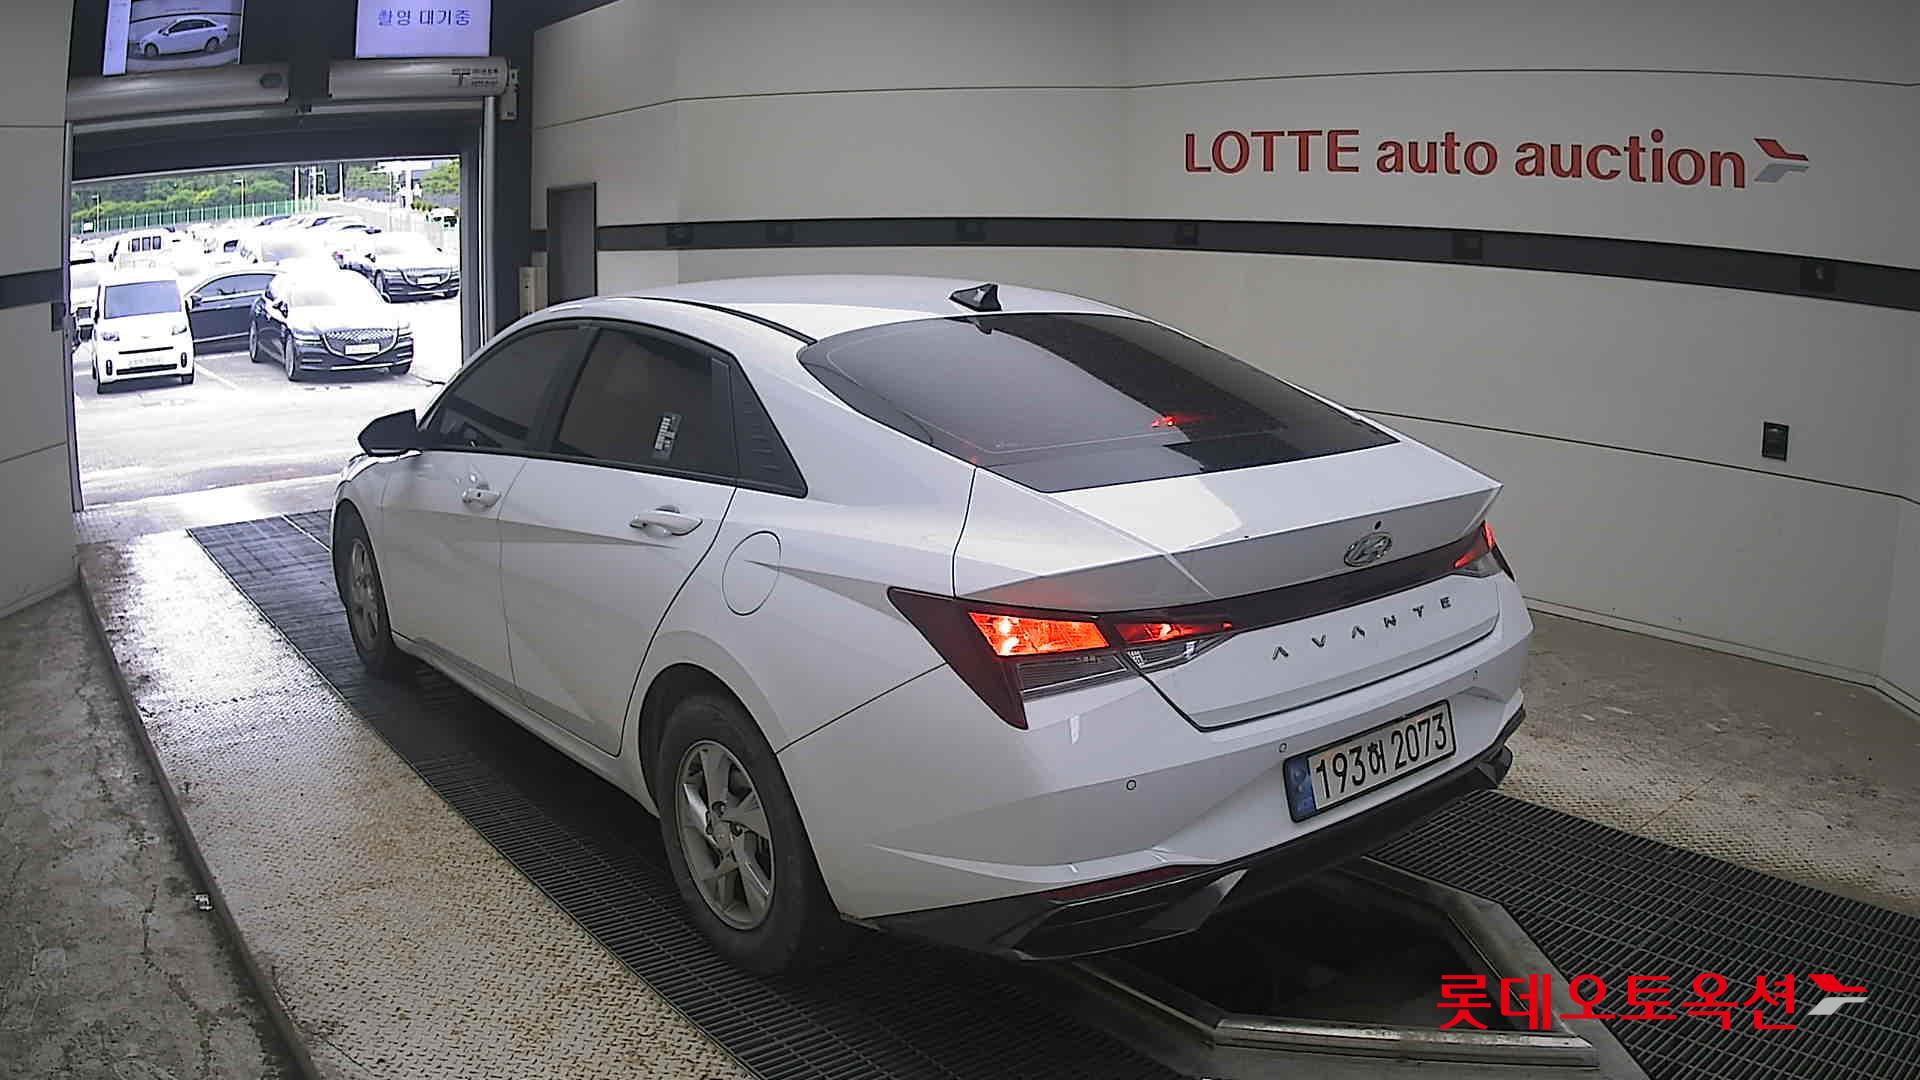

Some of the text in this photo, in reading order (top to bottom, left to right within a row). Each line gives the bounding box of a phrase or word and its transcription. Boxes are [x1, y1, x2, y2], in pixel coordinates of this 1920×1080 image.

[419, 9, 472, 26] 대기중
[1185, 128, 1746, 188] LOTTE auto auction
[1273, 596, 1452, 661] AVANTE
[1315, 712, 1447, 799] 193허 2073
